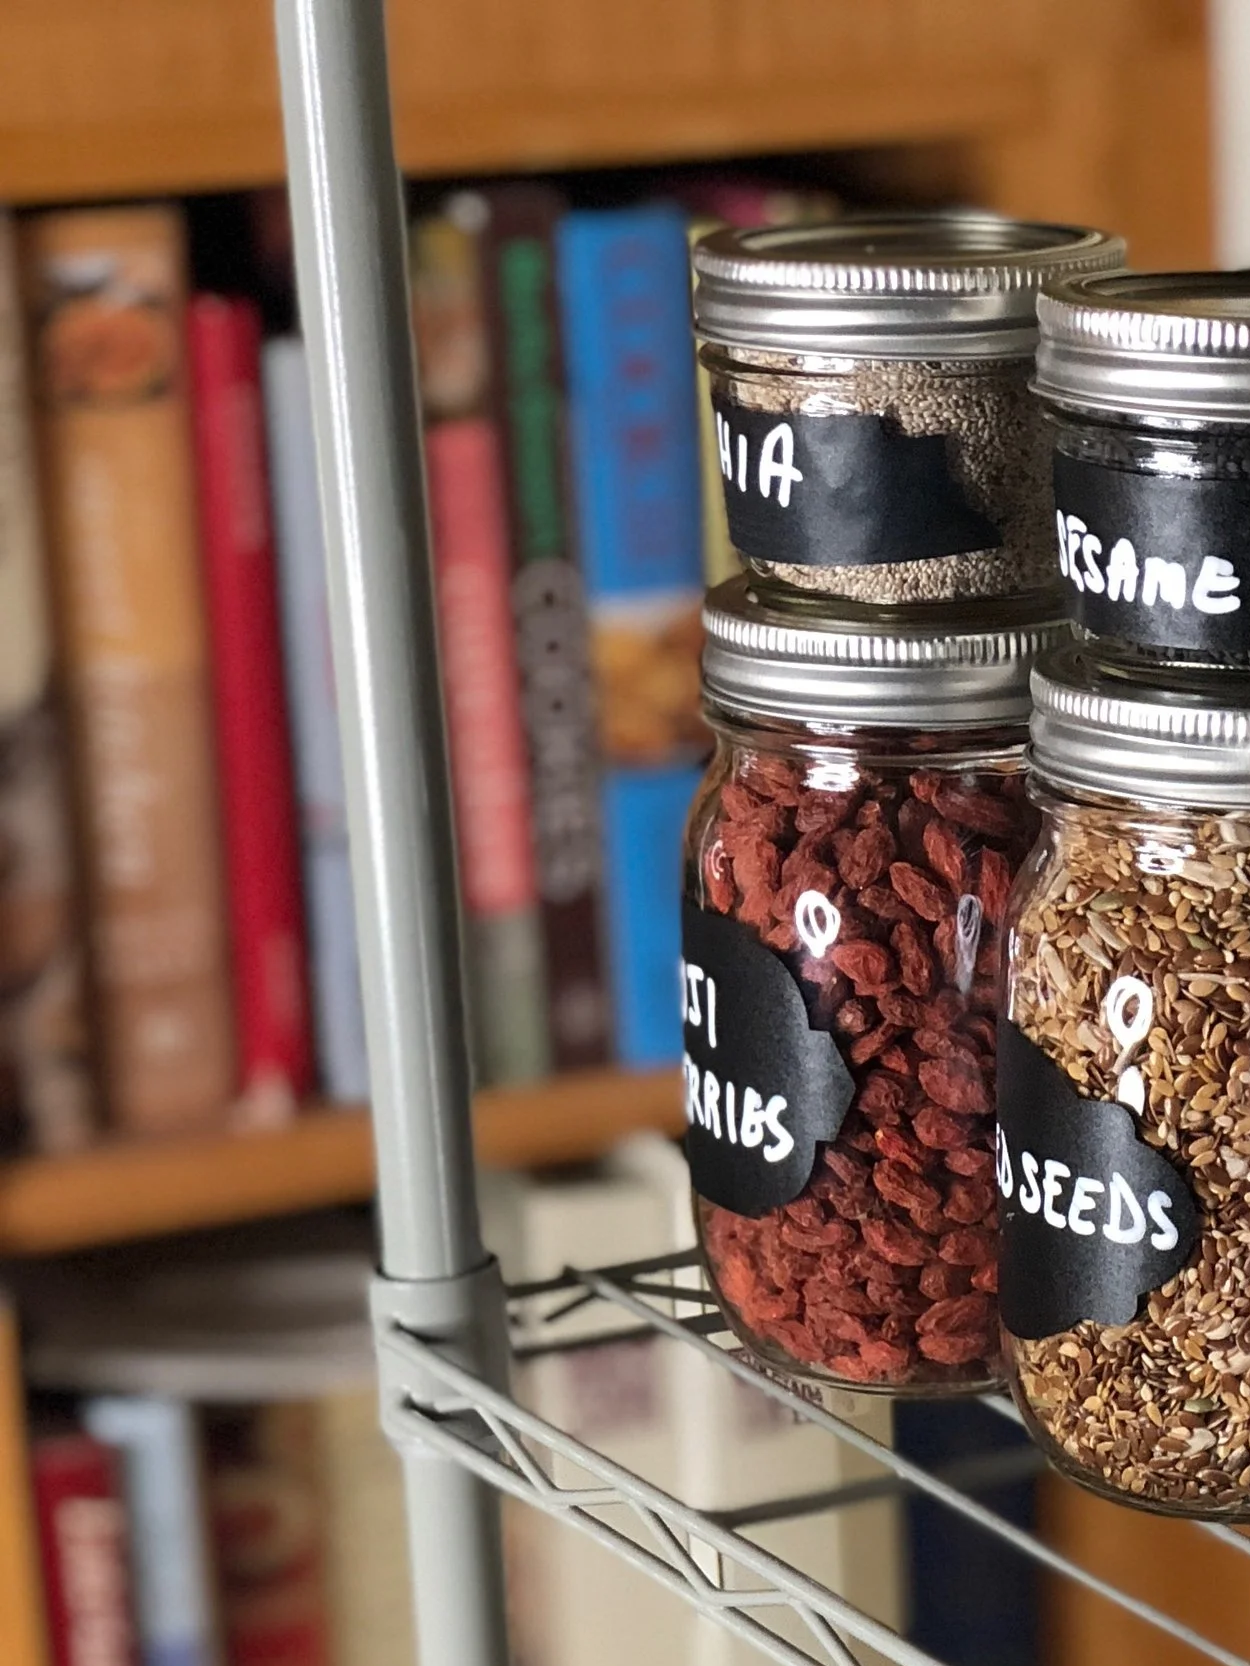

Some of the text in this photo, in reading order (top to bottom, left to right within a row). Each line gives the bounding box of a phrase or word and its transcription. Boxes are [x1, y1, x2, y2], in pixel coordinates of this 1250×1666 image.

[717, 412, 803, 507] HIA
[681, 955, 717, 1048] JI
[684, 1052, 794, 1162] RRIES
[1019, 1151, 1179, 1250] SEEDS
